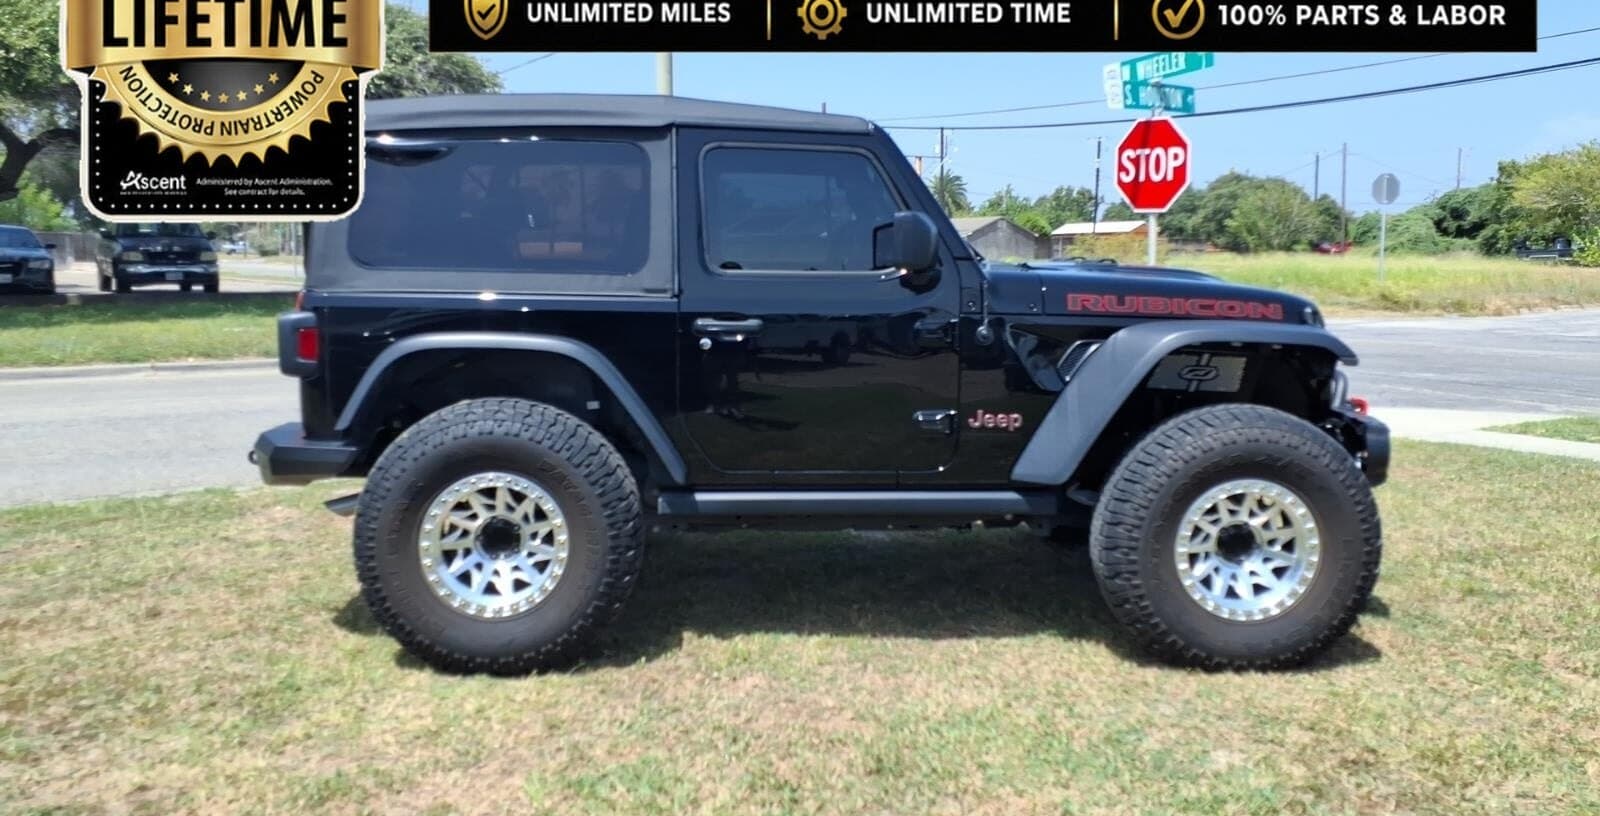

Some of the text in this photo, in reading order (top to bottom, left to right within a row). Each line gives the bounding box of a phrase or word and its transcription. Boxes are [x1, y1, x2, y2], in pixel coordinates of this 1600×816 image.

[1119, 146, 1186, 183] STOP
[1066, 293, 1284, 320] RUBICON
[967, 409, 1023, 432] Jeep
